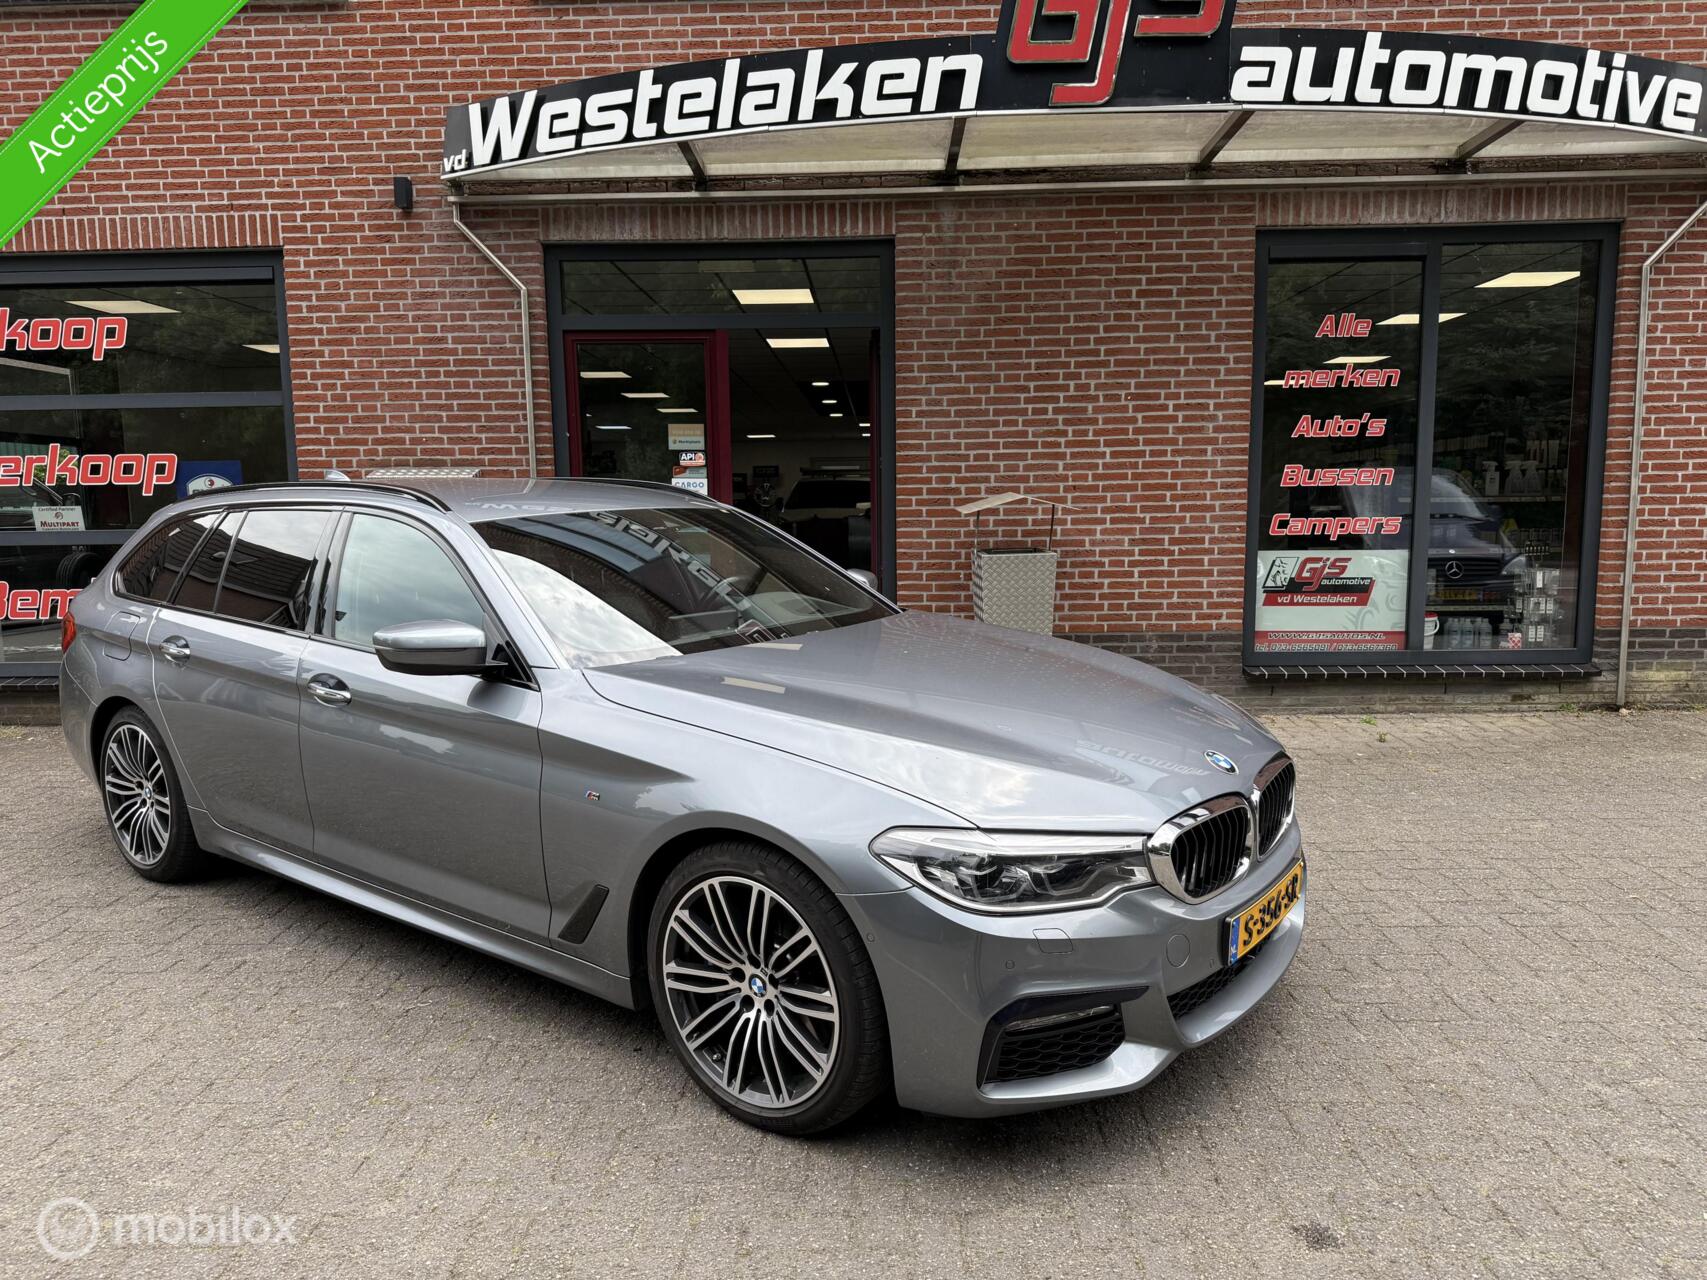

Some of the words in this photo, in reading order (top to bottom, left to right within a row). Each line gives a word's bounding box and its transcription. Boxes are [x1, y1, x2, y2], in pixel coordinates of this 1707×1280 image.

[1229, 31, 1704, 132] automotive
[443, 149, 467, 172] vd
[468, 48, 984, 167] Westelaken
[1314, 312, 1373, 338] Alle
[1282, 363, 1401, 388] merken
[1290, 412, 1387, 438] Auto's
[0, 443, 178, 496] erkoop
[1280, 464, 1395, 487] Bussen
[1269, 513, 1402, 541] Campers
[1321, 577, 1371, 585] automotive
[1277, 594, 1291, 603] vd
[1293, 594, 1358, 603] Westelaken
